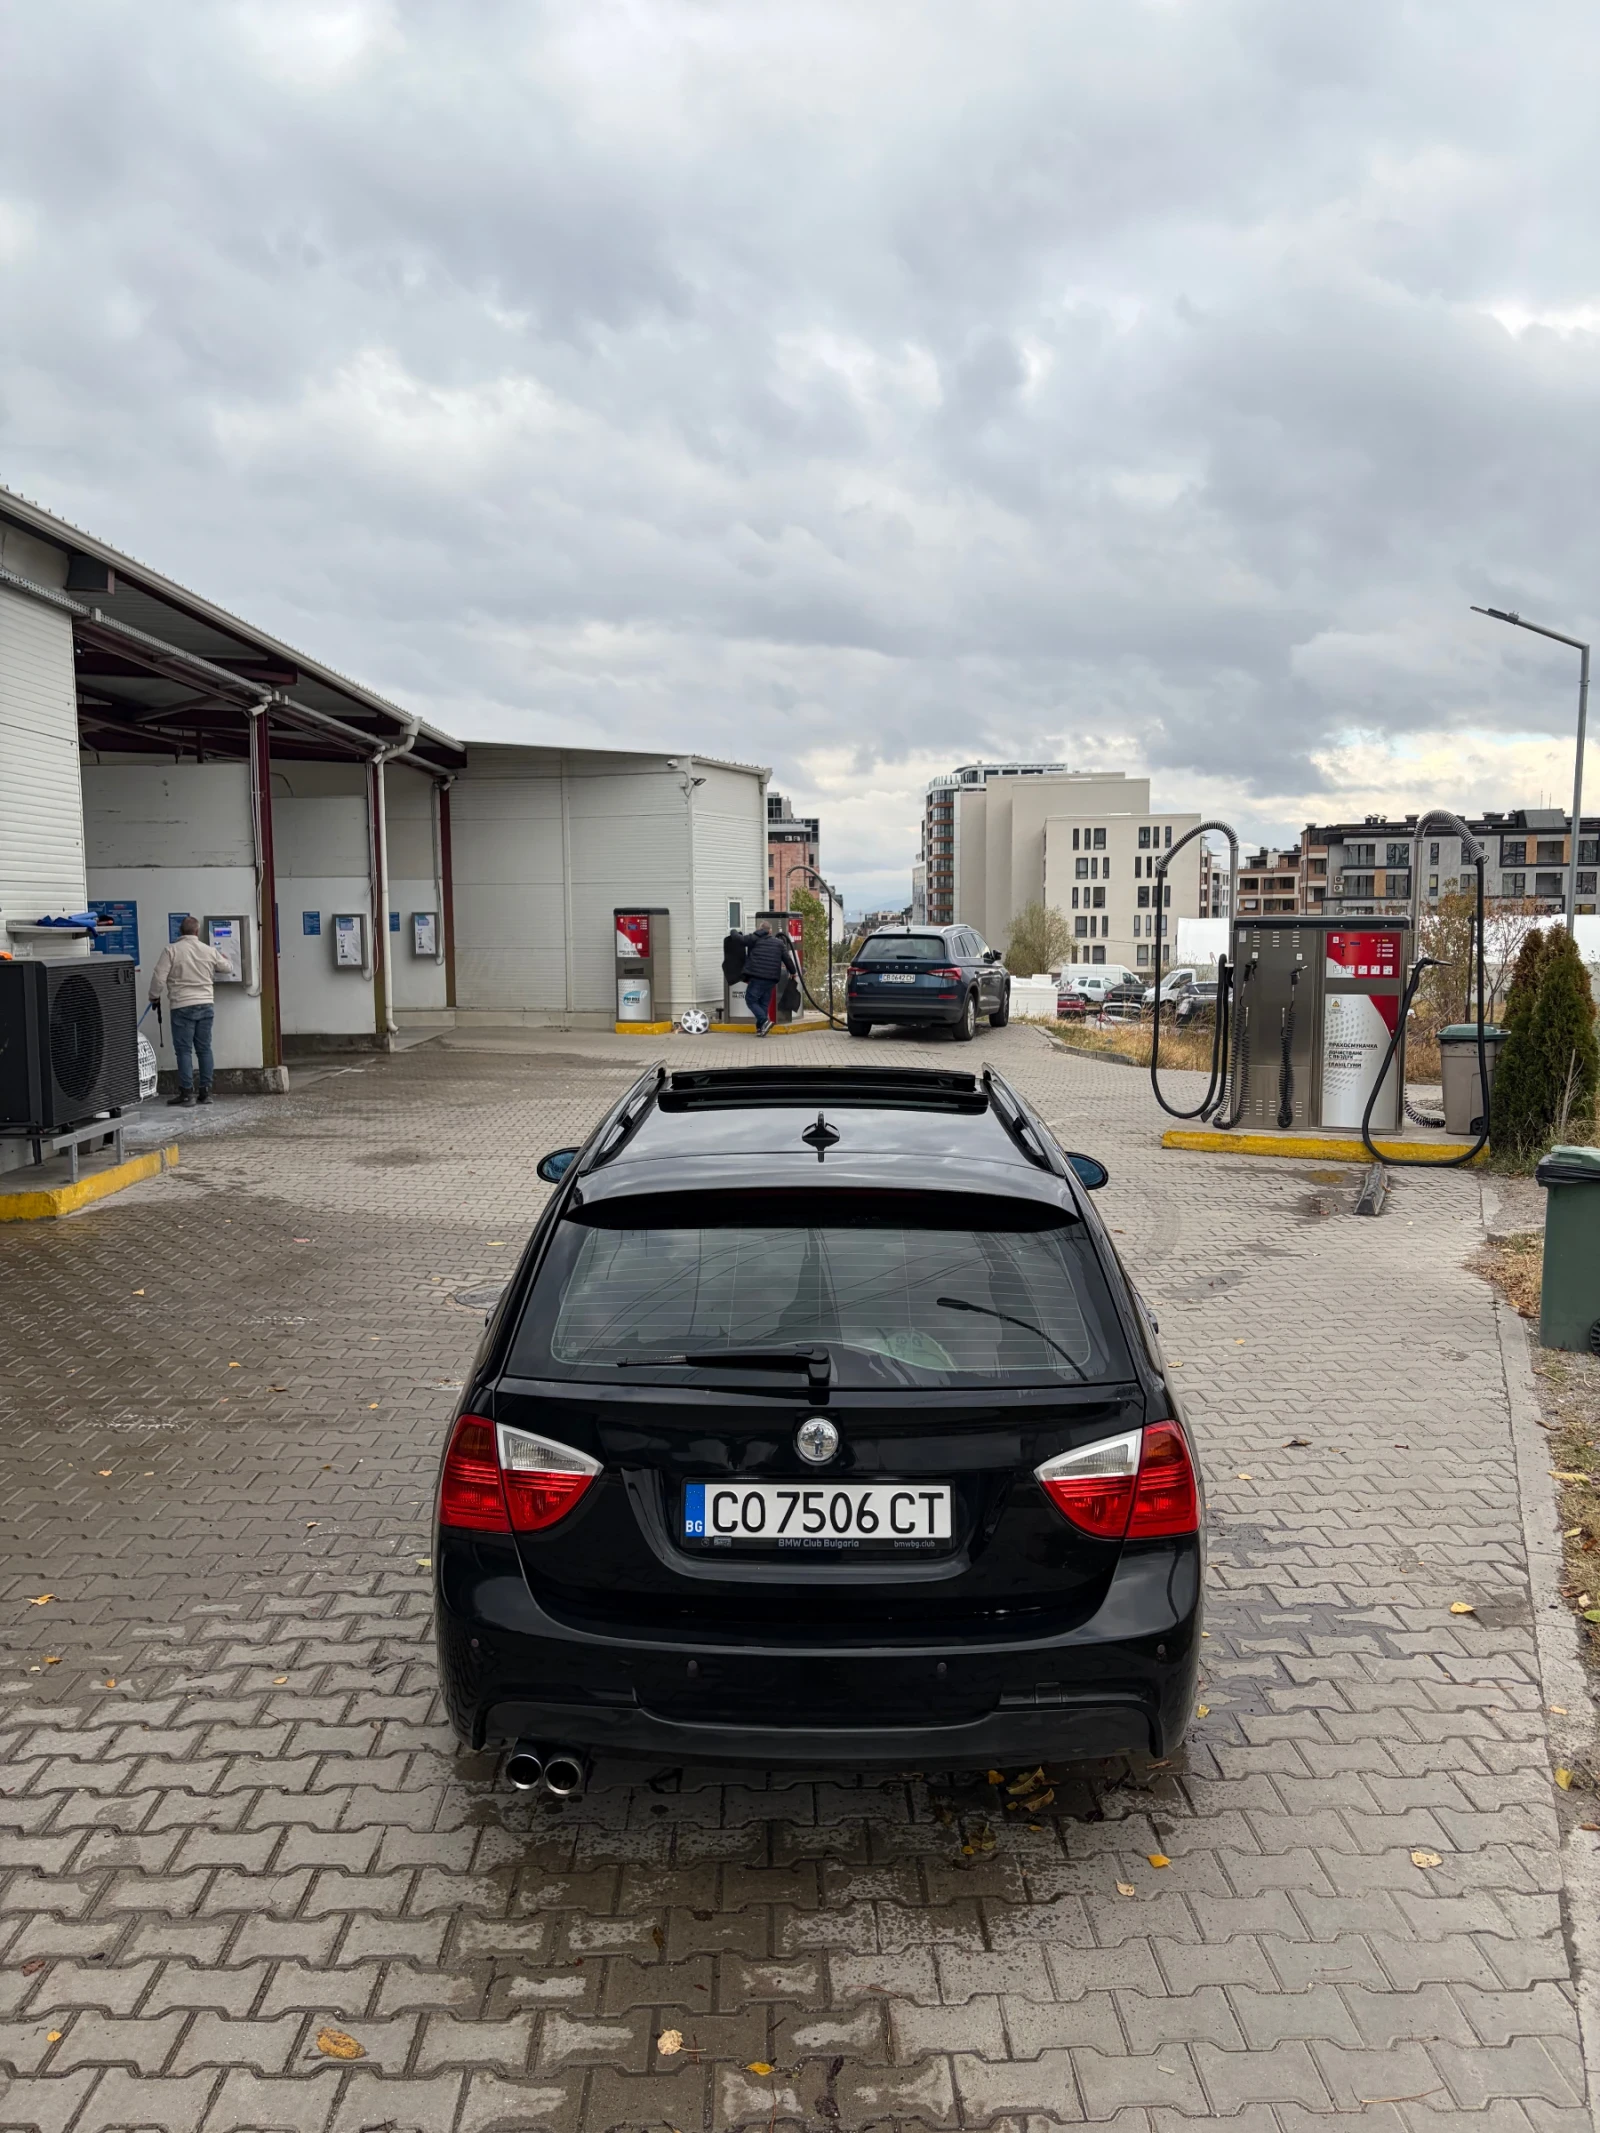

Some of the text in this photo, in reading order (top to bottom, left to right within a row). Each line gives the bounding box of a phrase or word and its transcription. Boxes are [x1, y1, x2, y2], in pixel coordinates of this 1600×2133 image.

[712, 1490, 944, 1535] CO 7506 CT
[685, 1520, 703, 1533] BG
[778, 1538, 860, 1549] BMW Club Bulgaria
[894, 1539, 936, 1549] bmwbg.club
